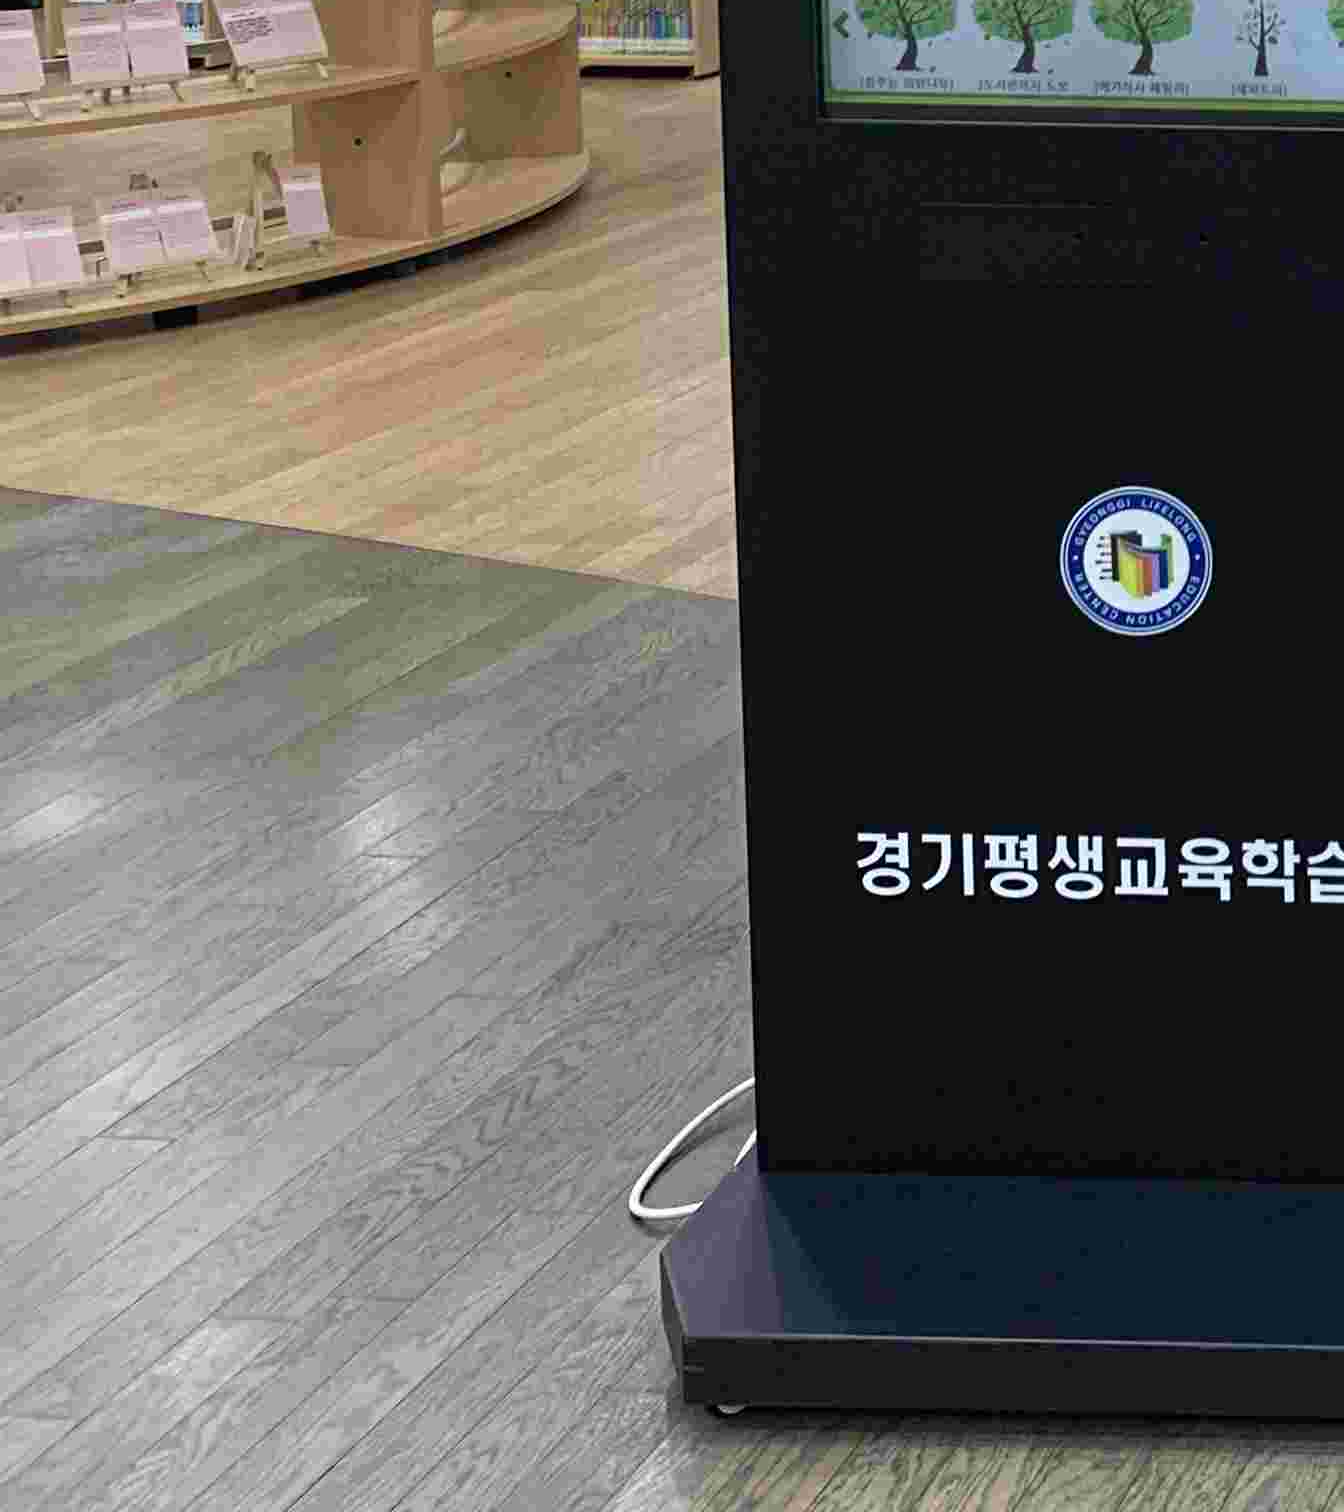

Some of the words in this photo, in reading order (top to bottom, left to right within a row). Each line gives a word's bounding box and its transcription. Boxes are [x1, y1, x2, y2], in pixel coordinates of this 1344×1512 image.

[1073, 496, 1132, 548] GYEONGGI
[1141, 496, 1199, 543] LIFELONG
[1125, 574, 1201, 626] EDUCATION
